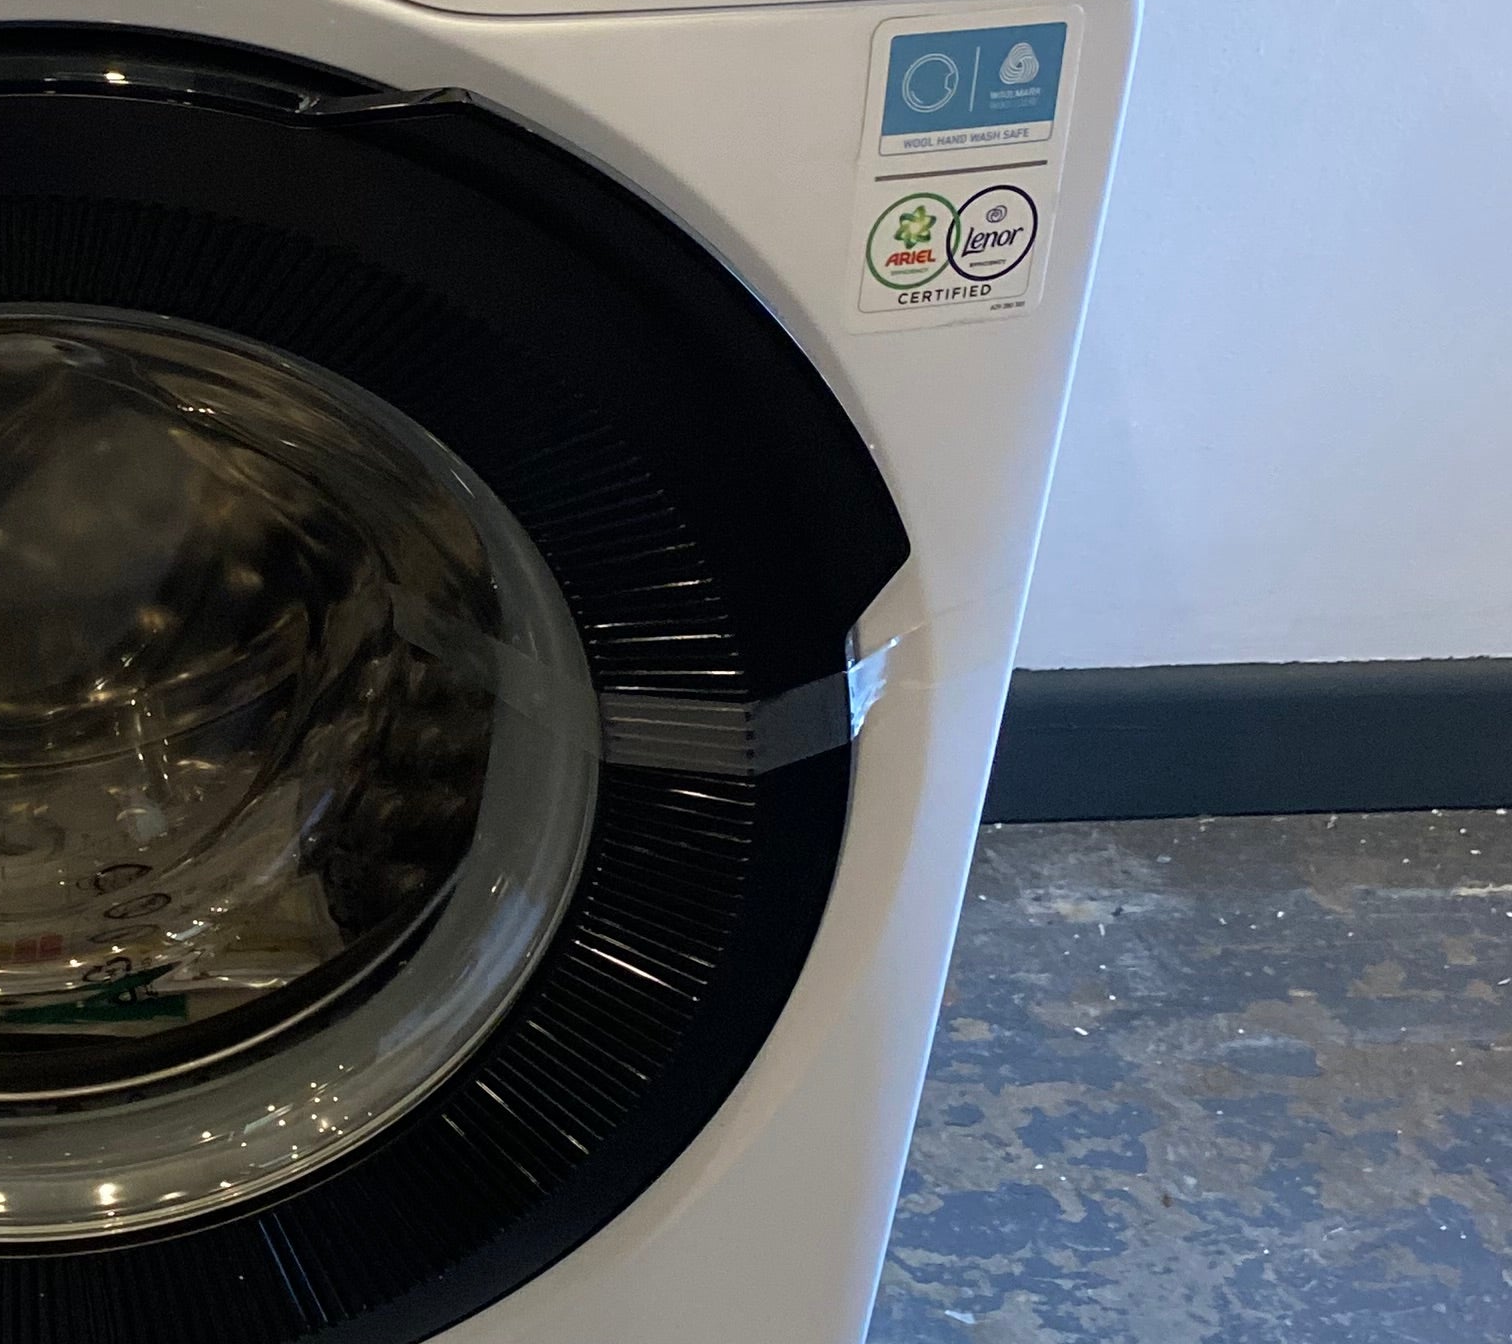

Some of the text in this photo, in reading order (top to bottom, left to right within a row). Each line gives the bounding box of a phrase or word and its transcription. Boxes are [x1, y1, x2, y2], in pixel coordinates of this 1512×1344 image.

[903, 127, 1030, 149] WOOL HAND WASH SAFE
[962, 226, 1024, 258] Lenor
[885, 249, 937, 267] ARIEL
[898, 284, 992, 305] CERTIFIED
